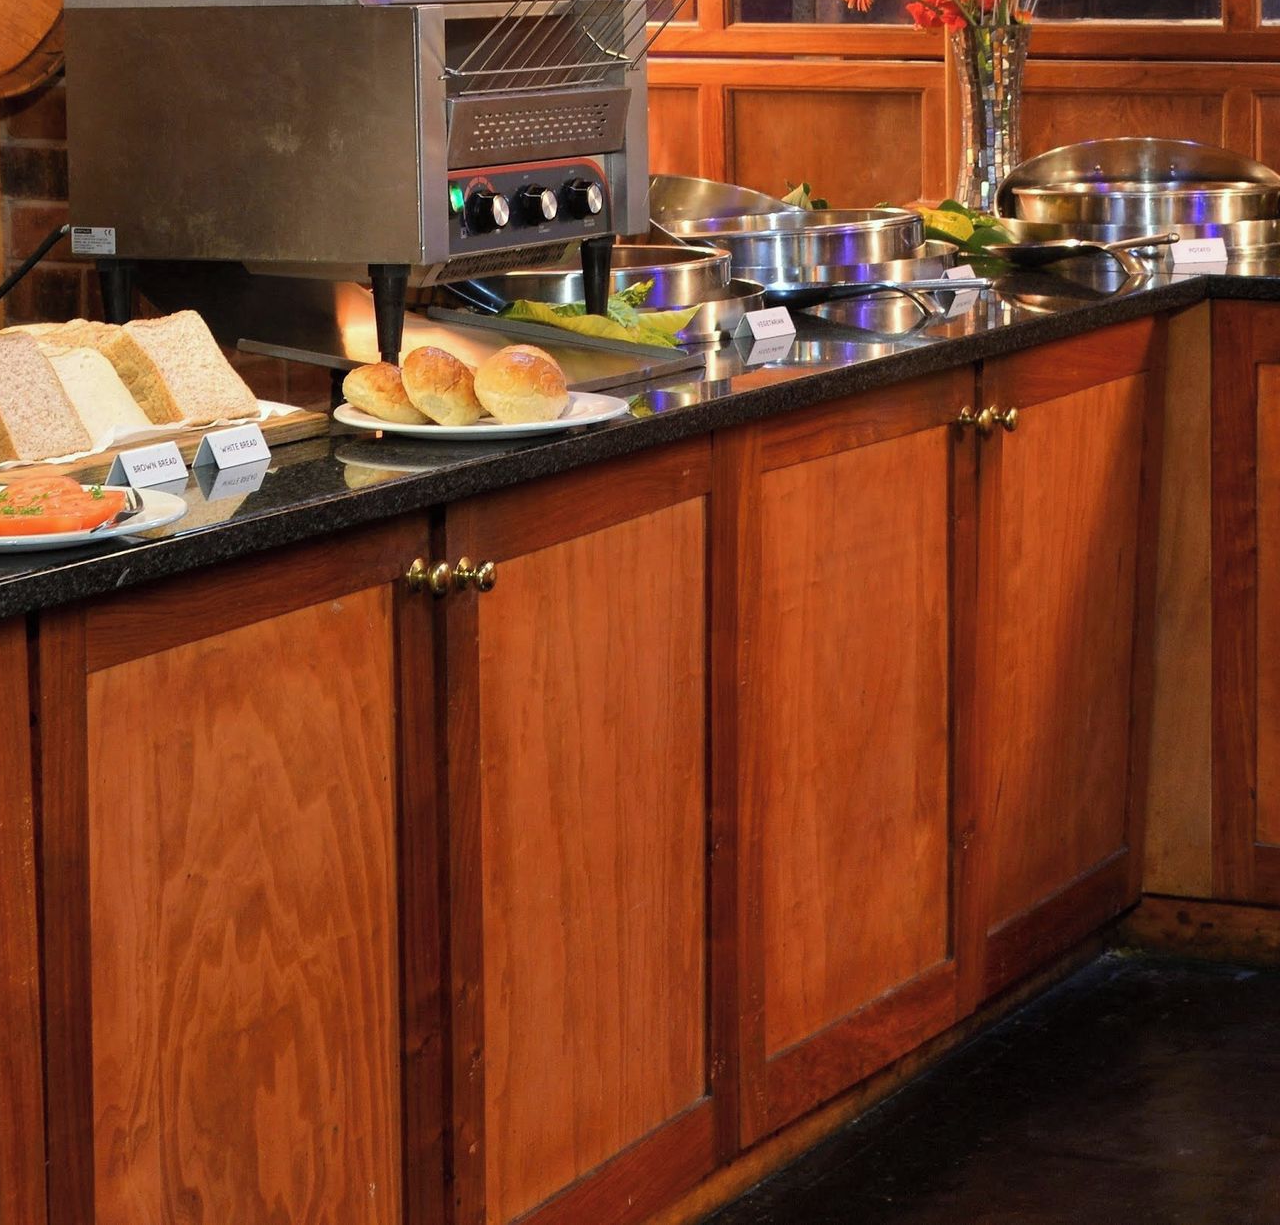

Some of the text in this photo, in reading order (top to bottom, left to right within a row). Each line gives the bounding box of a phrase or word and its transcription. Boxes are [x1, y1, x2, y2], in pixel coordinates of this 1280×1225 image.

[221, 439, 258, 453] WHITE BREAD
[132, 457, 178, 474] BROWN BREAD
